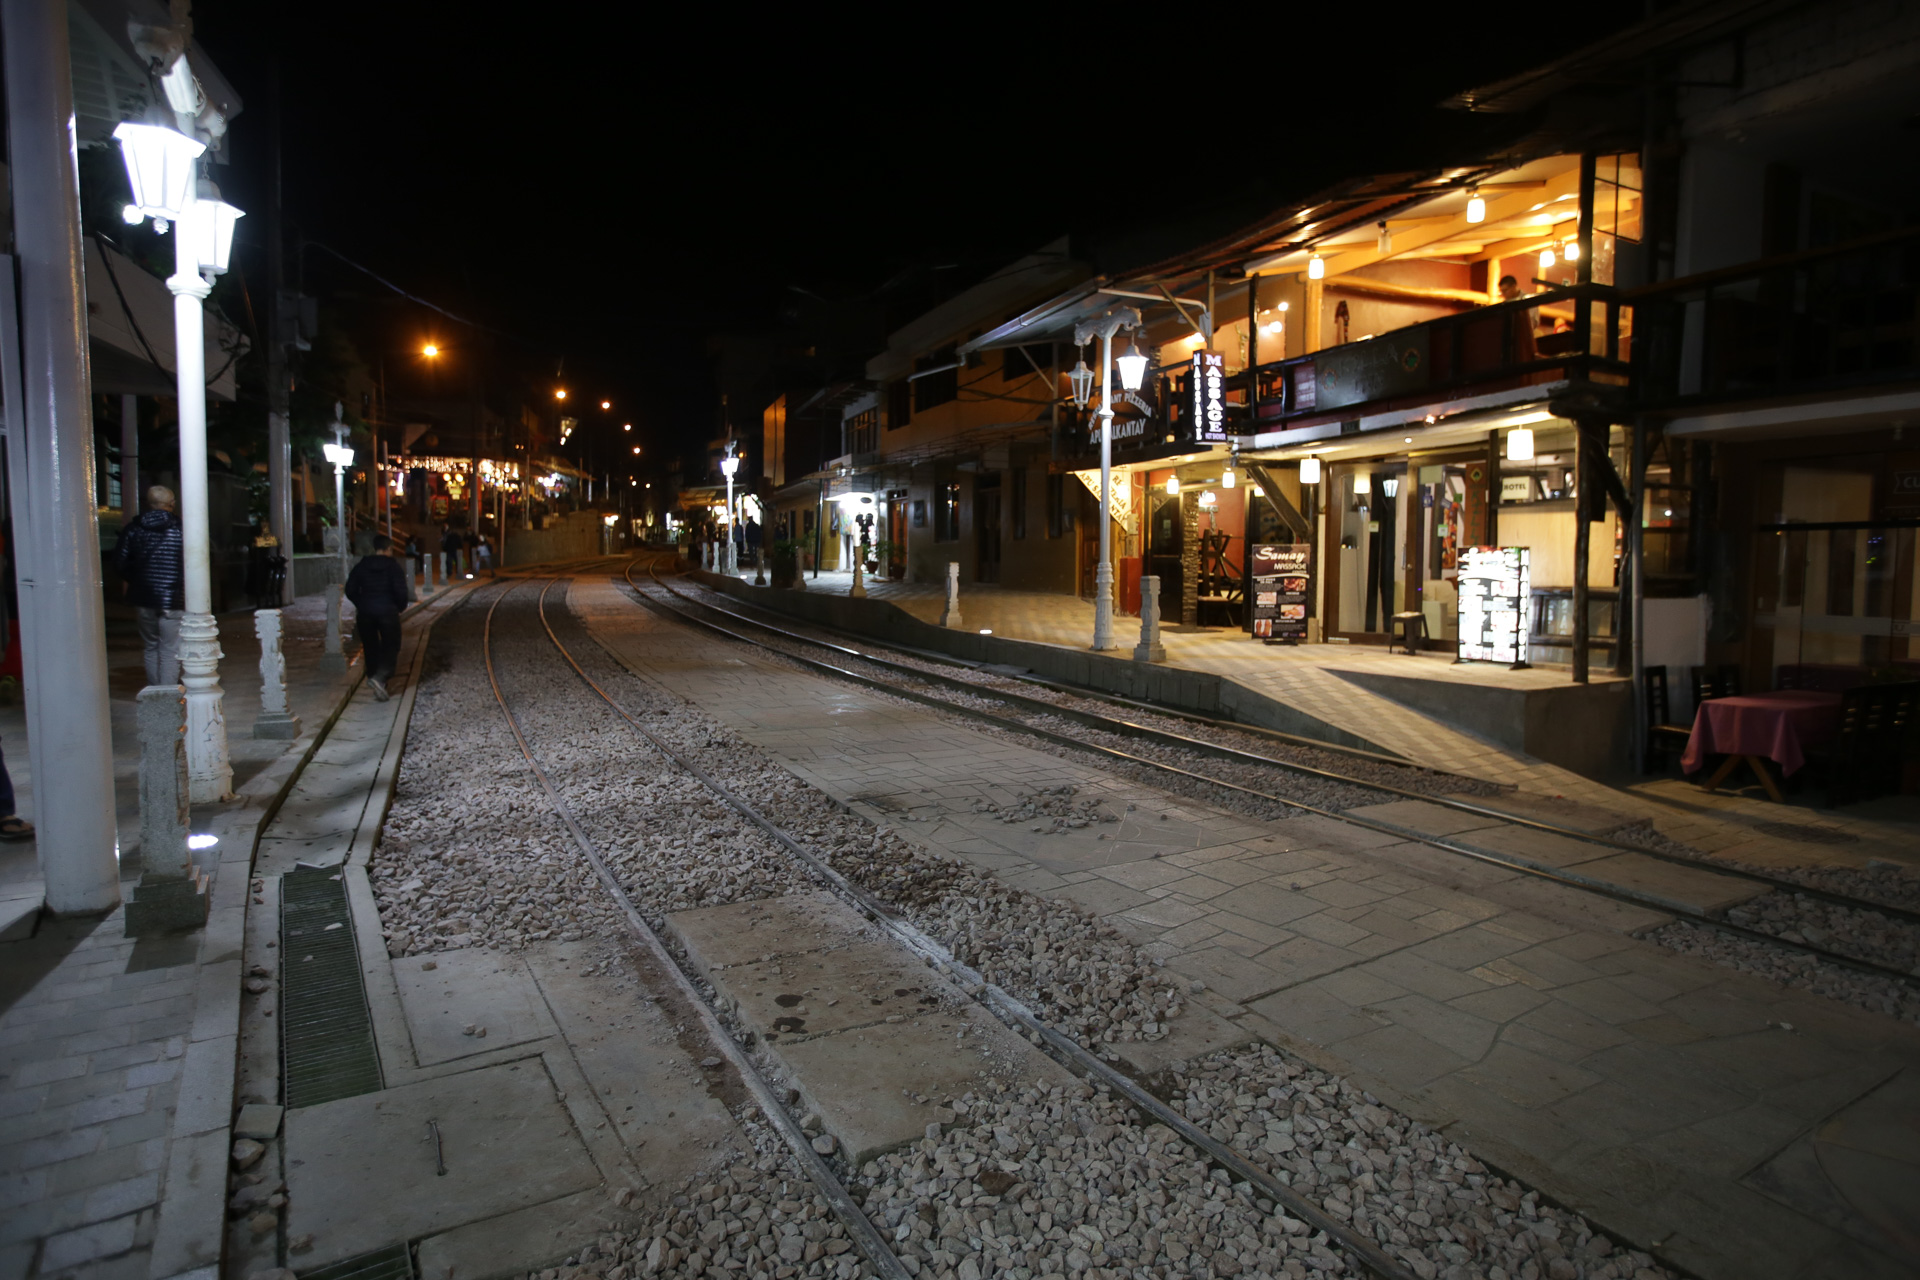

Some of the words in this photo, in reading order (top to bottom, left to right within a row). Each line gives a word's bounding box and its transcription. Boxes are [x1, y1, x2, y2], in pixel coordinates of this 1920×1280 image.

[1193, 352, 1203, 441] MASSAGE
[1205, 354, 1223, 432] MASSAGE
[1503, 483, 1526, 491] HOTEL
[1255, 546, 1306, 565] Samay
[1273, 562, 1307, 571] MASSAGE
